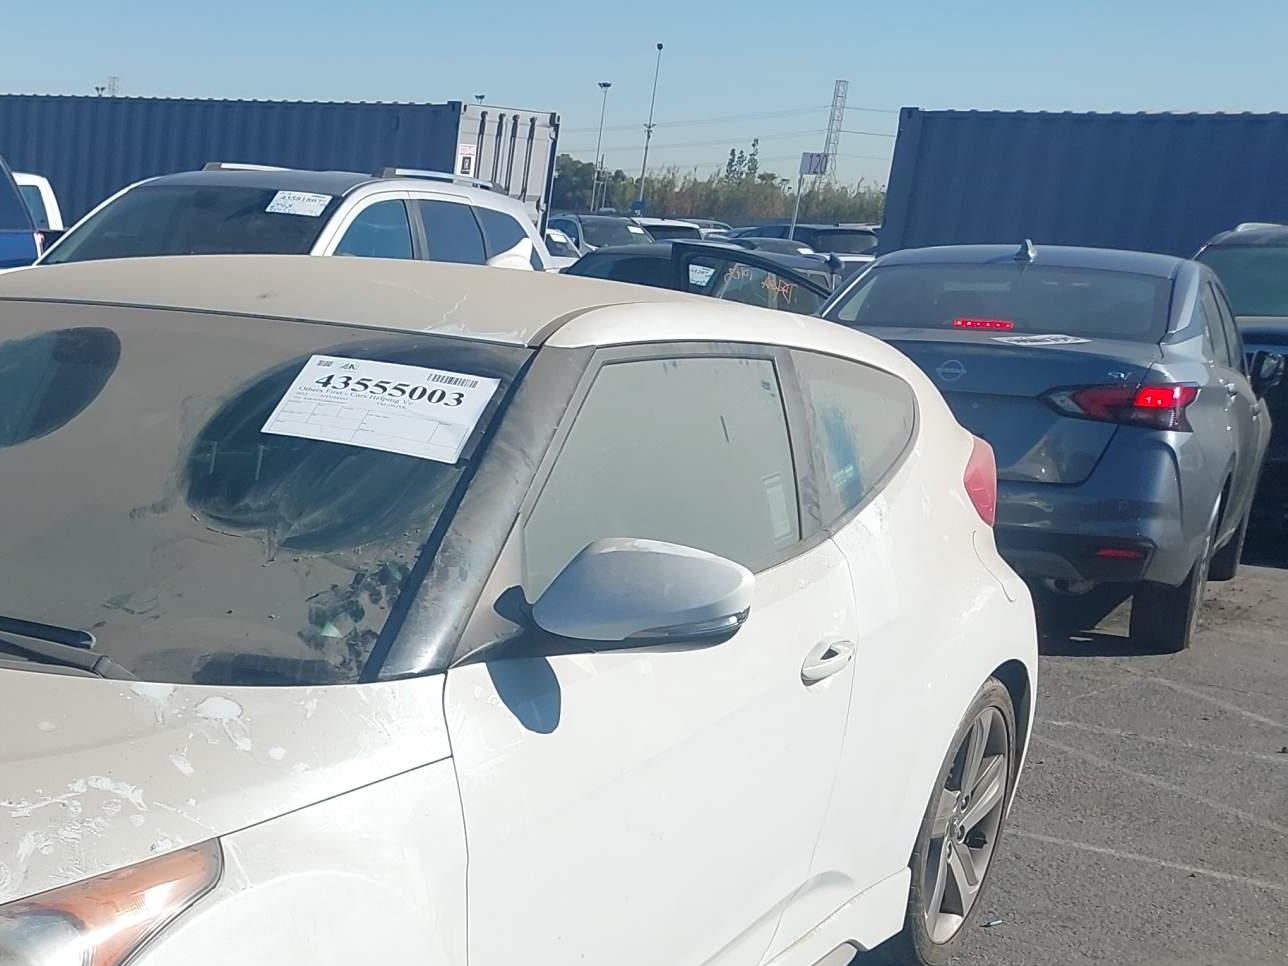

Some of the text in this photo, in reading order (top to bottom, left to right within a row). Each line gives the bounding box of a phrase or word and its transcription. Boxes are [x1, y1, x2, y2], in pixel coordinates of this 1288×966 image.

[808, 153, 828, 175] 120
[315, 374, 465, 407] 43555003
[368, 393, 400, 404] Helping
